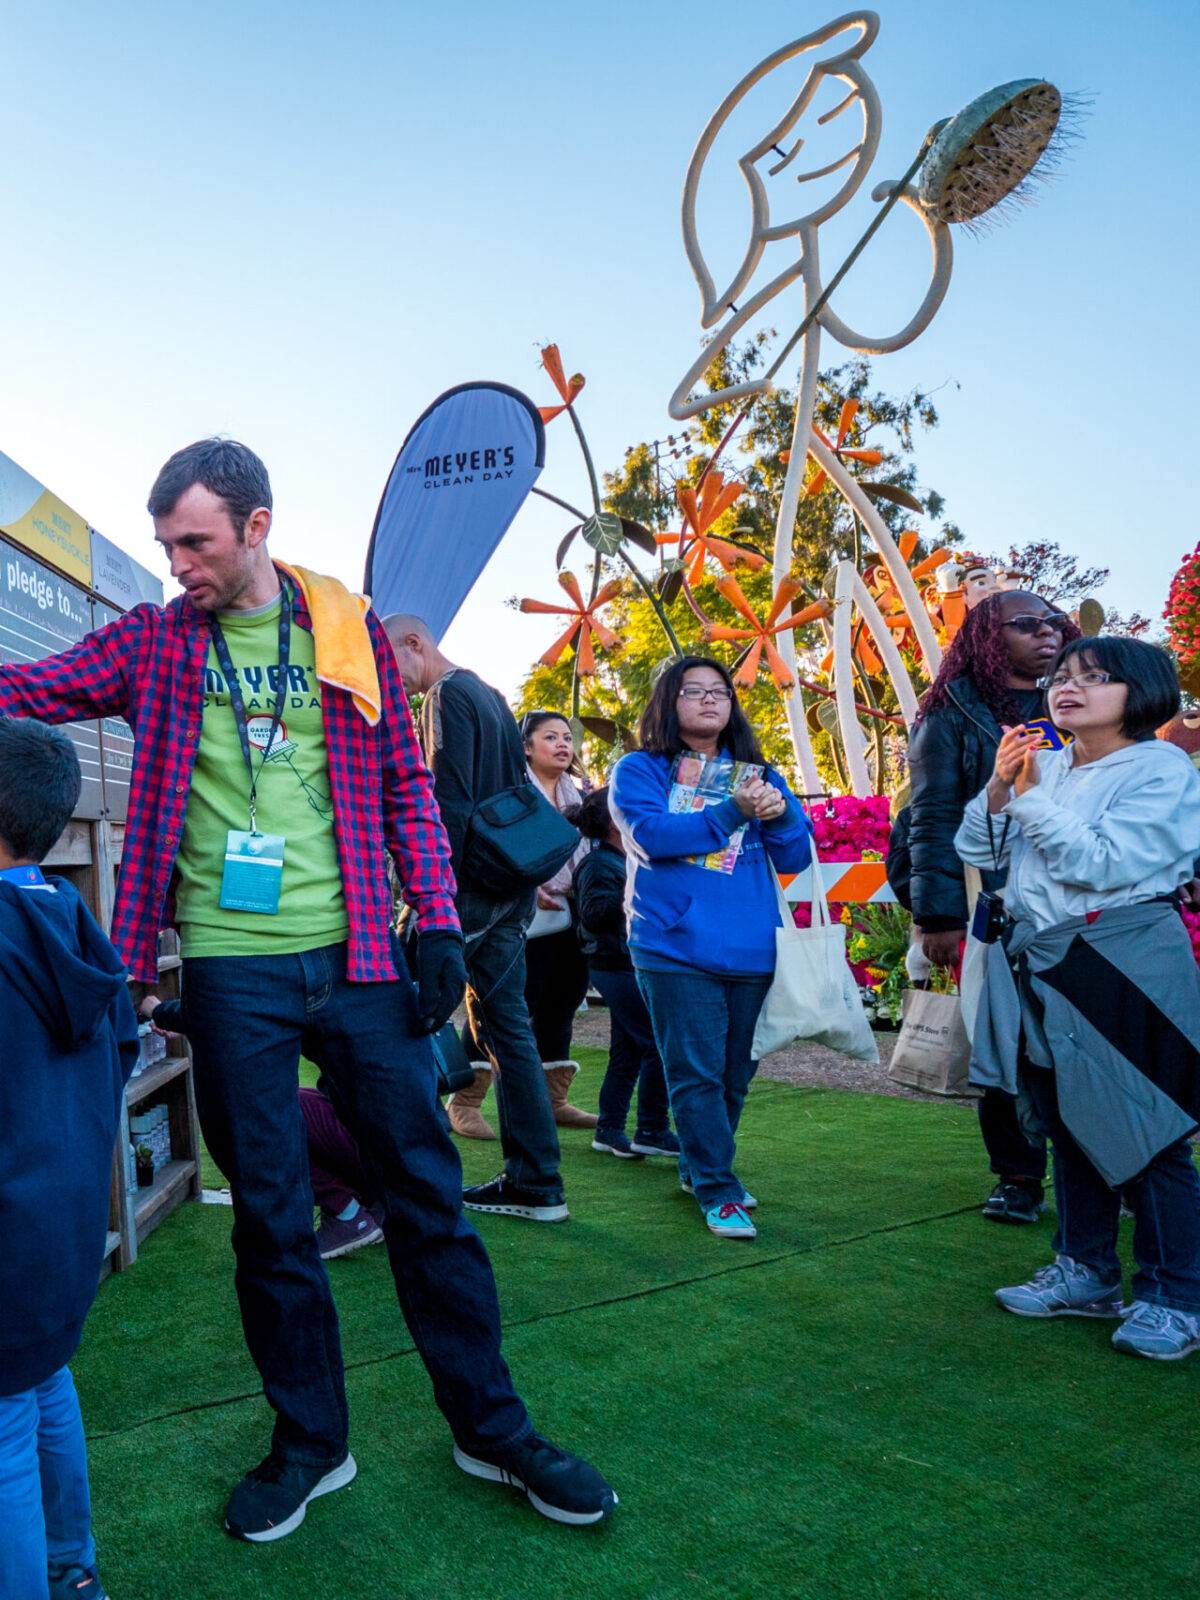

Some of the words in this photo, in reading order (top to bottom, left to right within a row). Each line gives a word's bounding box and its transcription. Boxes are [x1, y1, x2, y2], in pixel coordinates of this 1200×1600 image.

[425, 446, 514, 478] MEYER'S
[424, 475, 474, 489] CLEAN
[483, 470, 513, 481] DAY
[7, 560, 53, 609] pledge
[57, 587, 82, 623] to...
[99, 567, 131, 593] LAVENDER
